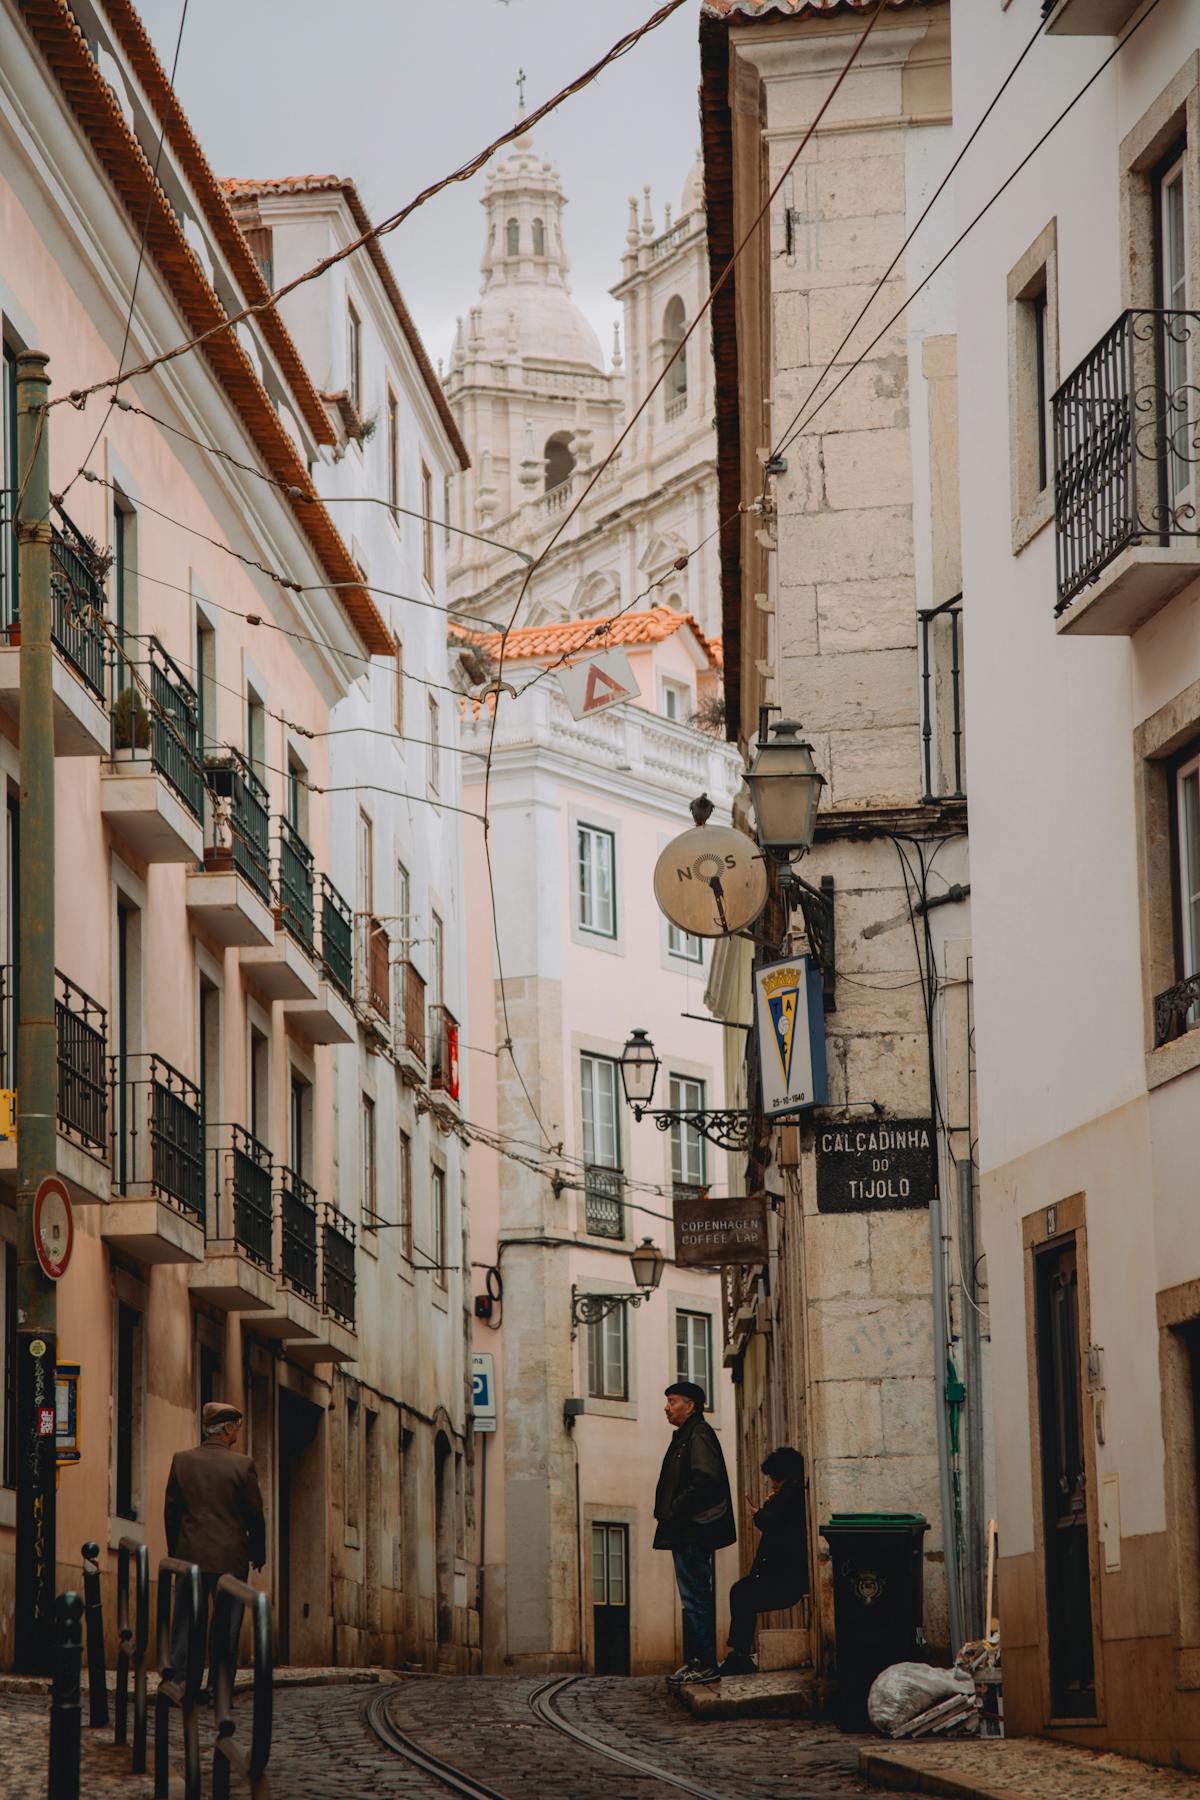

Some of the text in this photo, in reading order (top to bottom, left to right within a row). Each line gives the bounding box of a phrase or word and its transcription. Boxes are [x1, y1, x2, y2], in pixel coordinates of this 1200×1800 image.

[772, 1092, 805, 1108] 25-10-1940
[821, 1129, 930, 1157] CALÇADINHA
[872, 1158, 889, 1172] DO
[848, 1178, 910, 1199] TIJOLO
[680, 1219, 759, 1232] COPENHAGEN
[681, 1231, 759, 1245] COFFEE LAB
